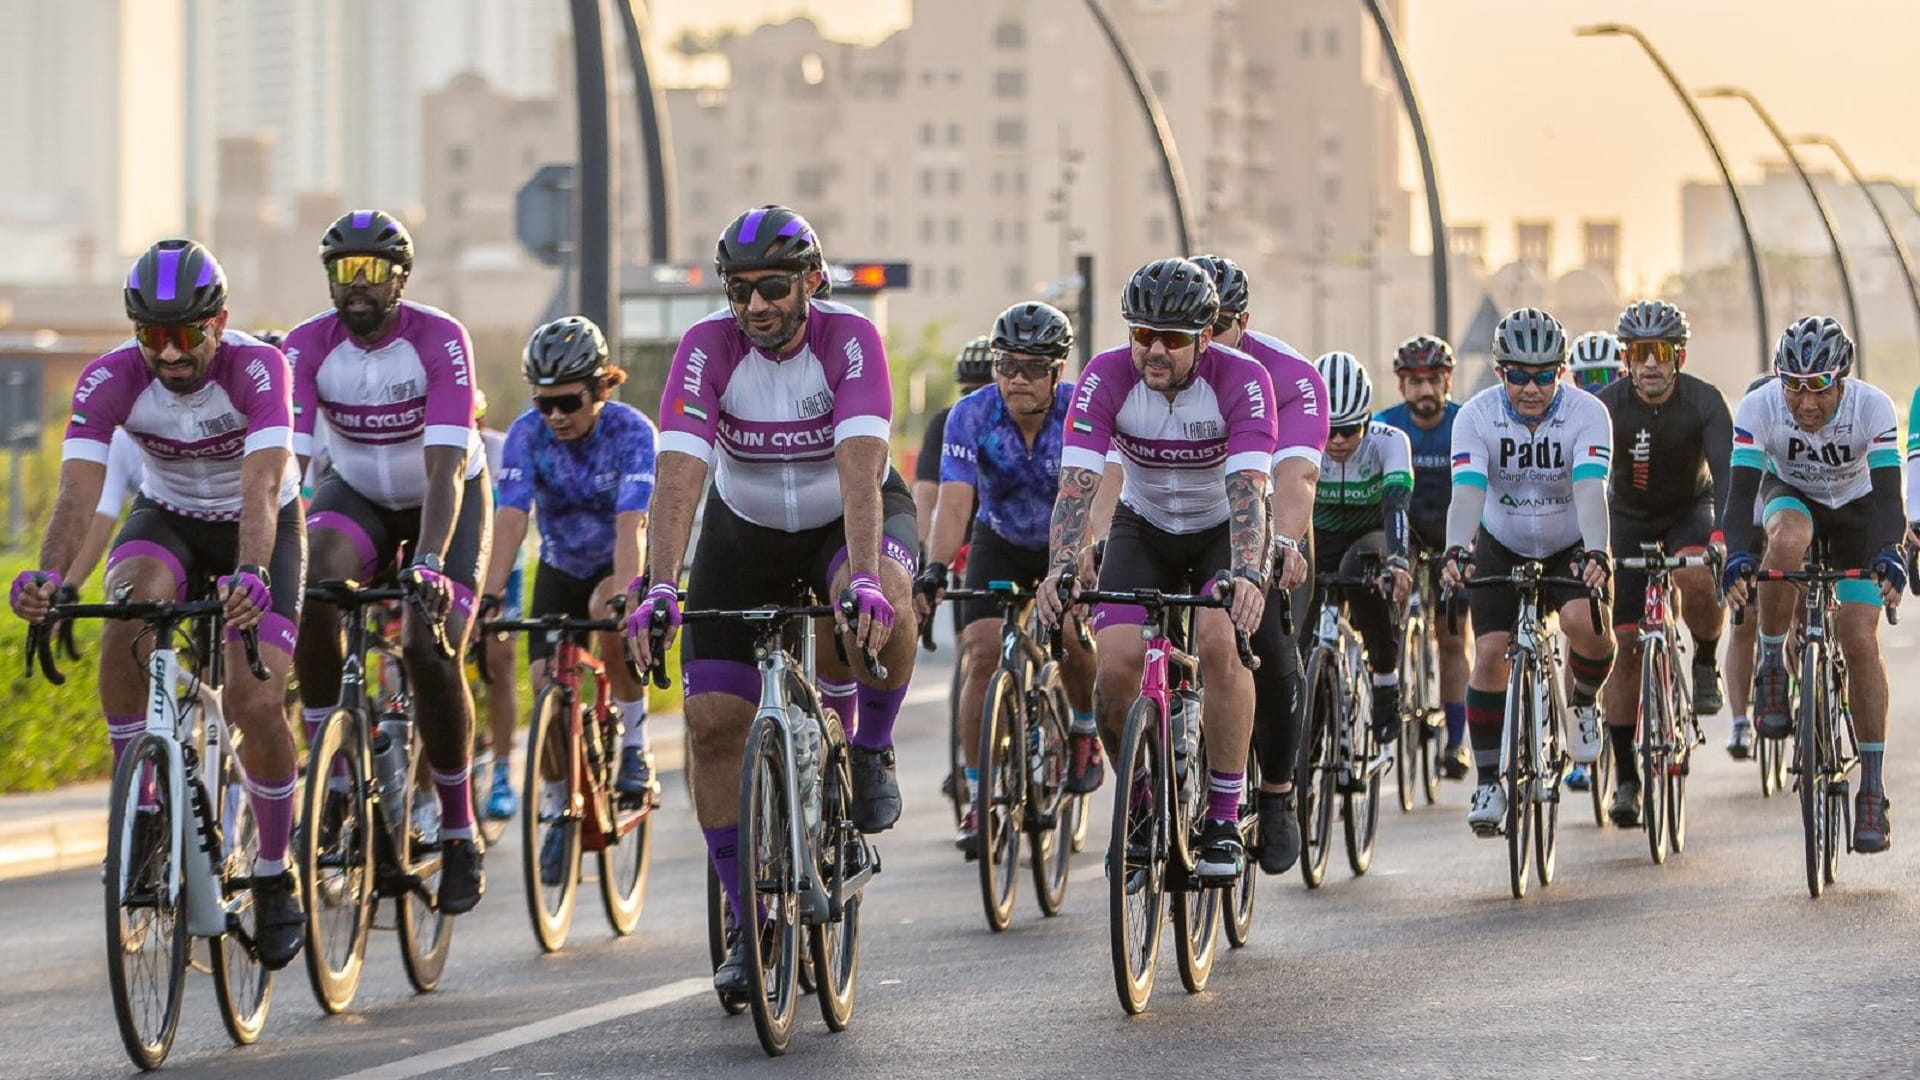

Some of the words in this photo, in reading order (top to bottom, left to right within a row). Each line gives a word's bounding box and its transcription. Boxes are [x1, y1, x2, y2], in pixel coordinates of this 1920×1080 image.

[444, 339, 469, 387] ALAIN
[683, 347, 709, 397] ALAIN
[75, 366, 113, 404] ALAIN
[1076, 372, 1102, 413] ALAIN
[1244, 379, 1266, 419] ALAIN
[1295, 377, 1319, 417] ALAIN
[717, 419, 764, 446] ALAIN
[771, 424, 834, 447] CYCLIS
[1499, 436, 1565, 469] Padz
[1787, 437, 1857, 467] Padz
[1499, 470, 1526, 482] Cargo
